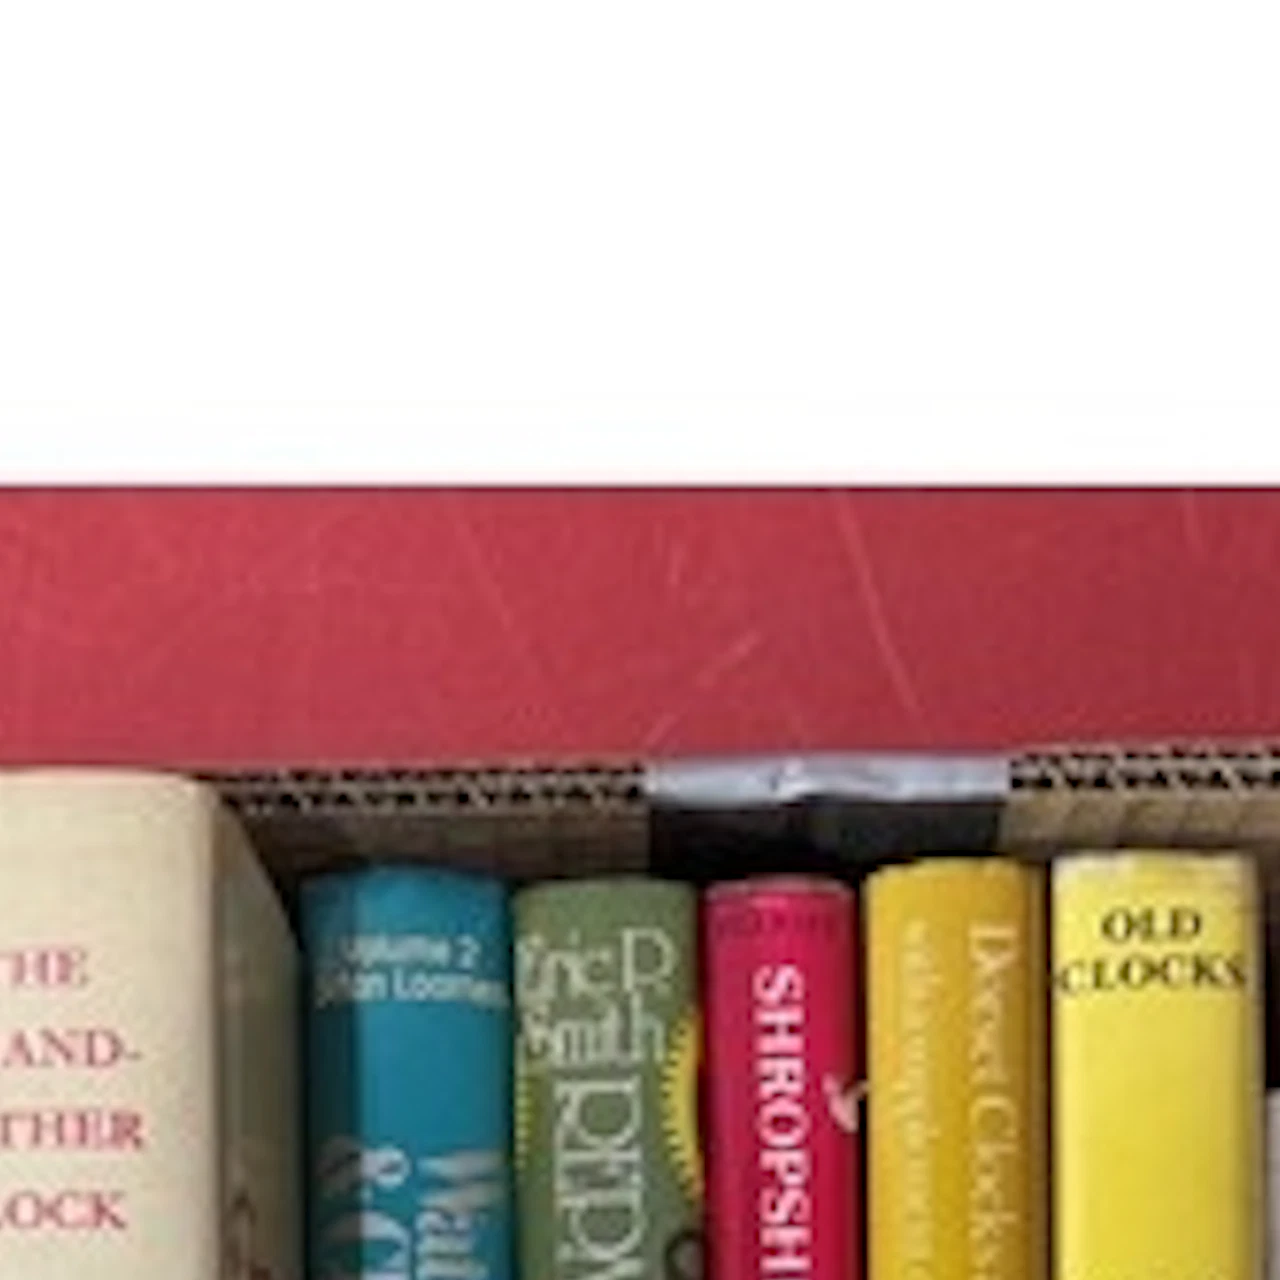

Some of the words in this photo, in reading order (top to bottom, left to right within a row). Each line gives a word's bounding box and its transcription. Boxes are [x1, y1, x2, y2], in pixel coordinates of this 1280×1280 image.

[1101, 907, 1202, 943] OLD
[458, 937, 481, 971] 2
[1058, 953, 1249, 995] CLOCKS
[970, 1096, 1018, 1267] Clocks
